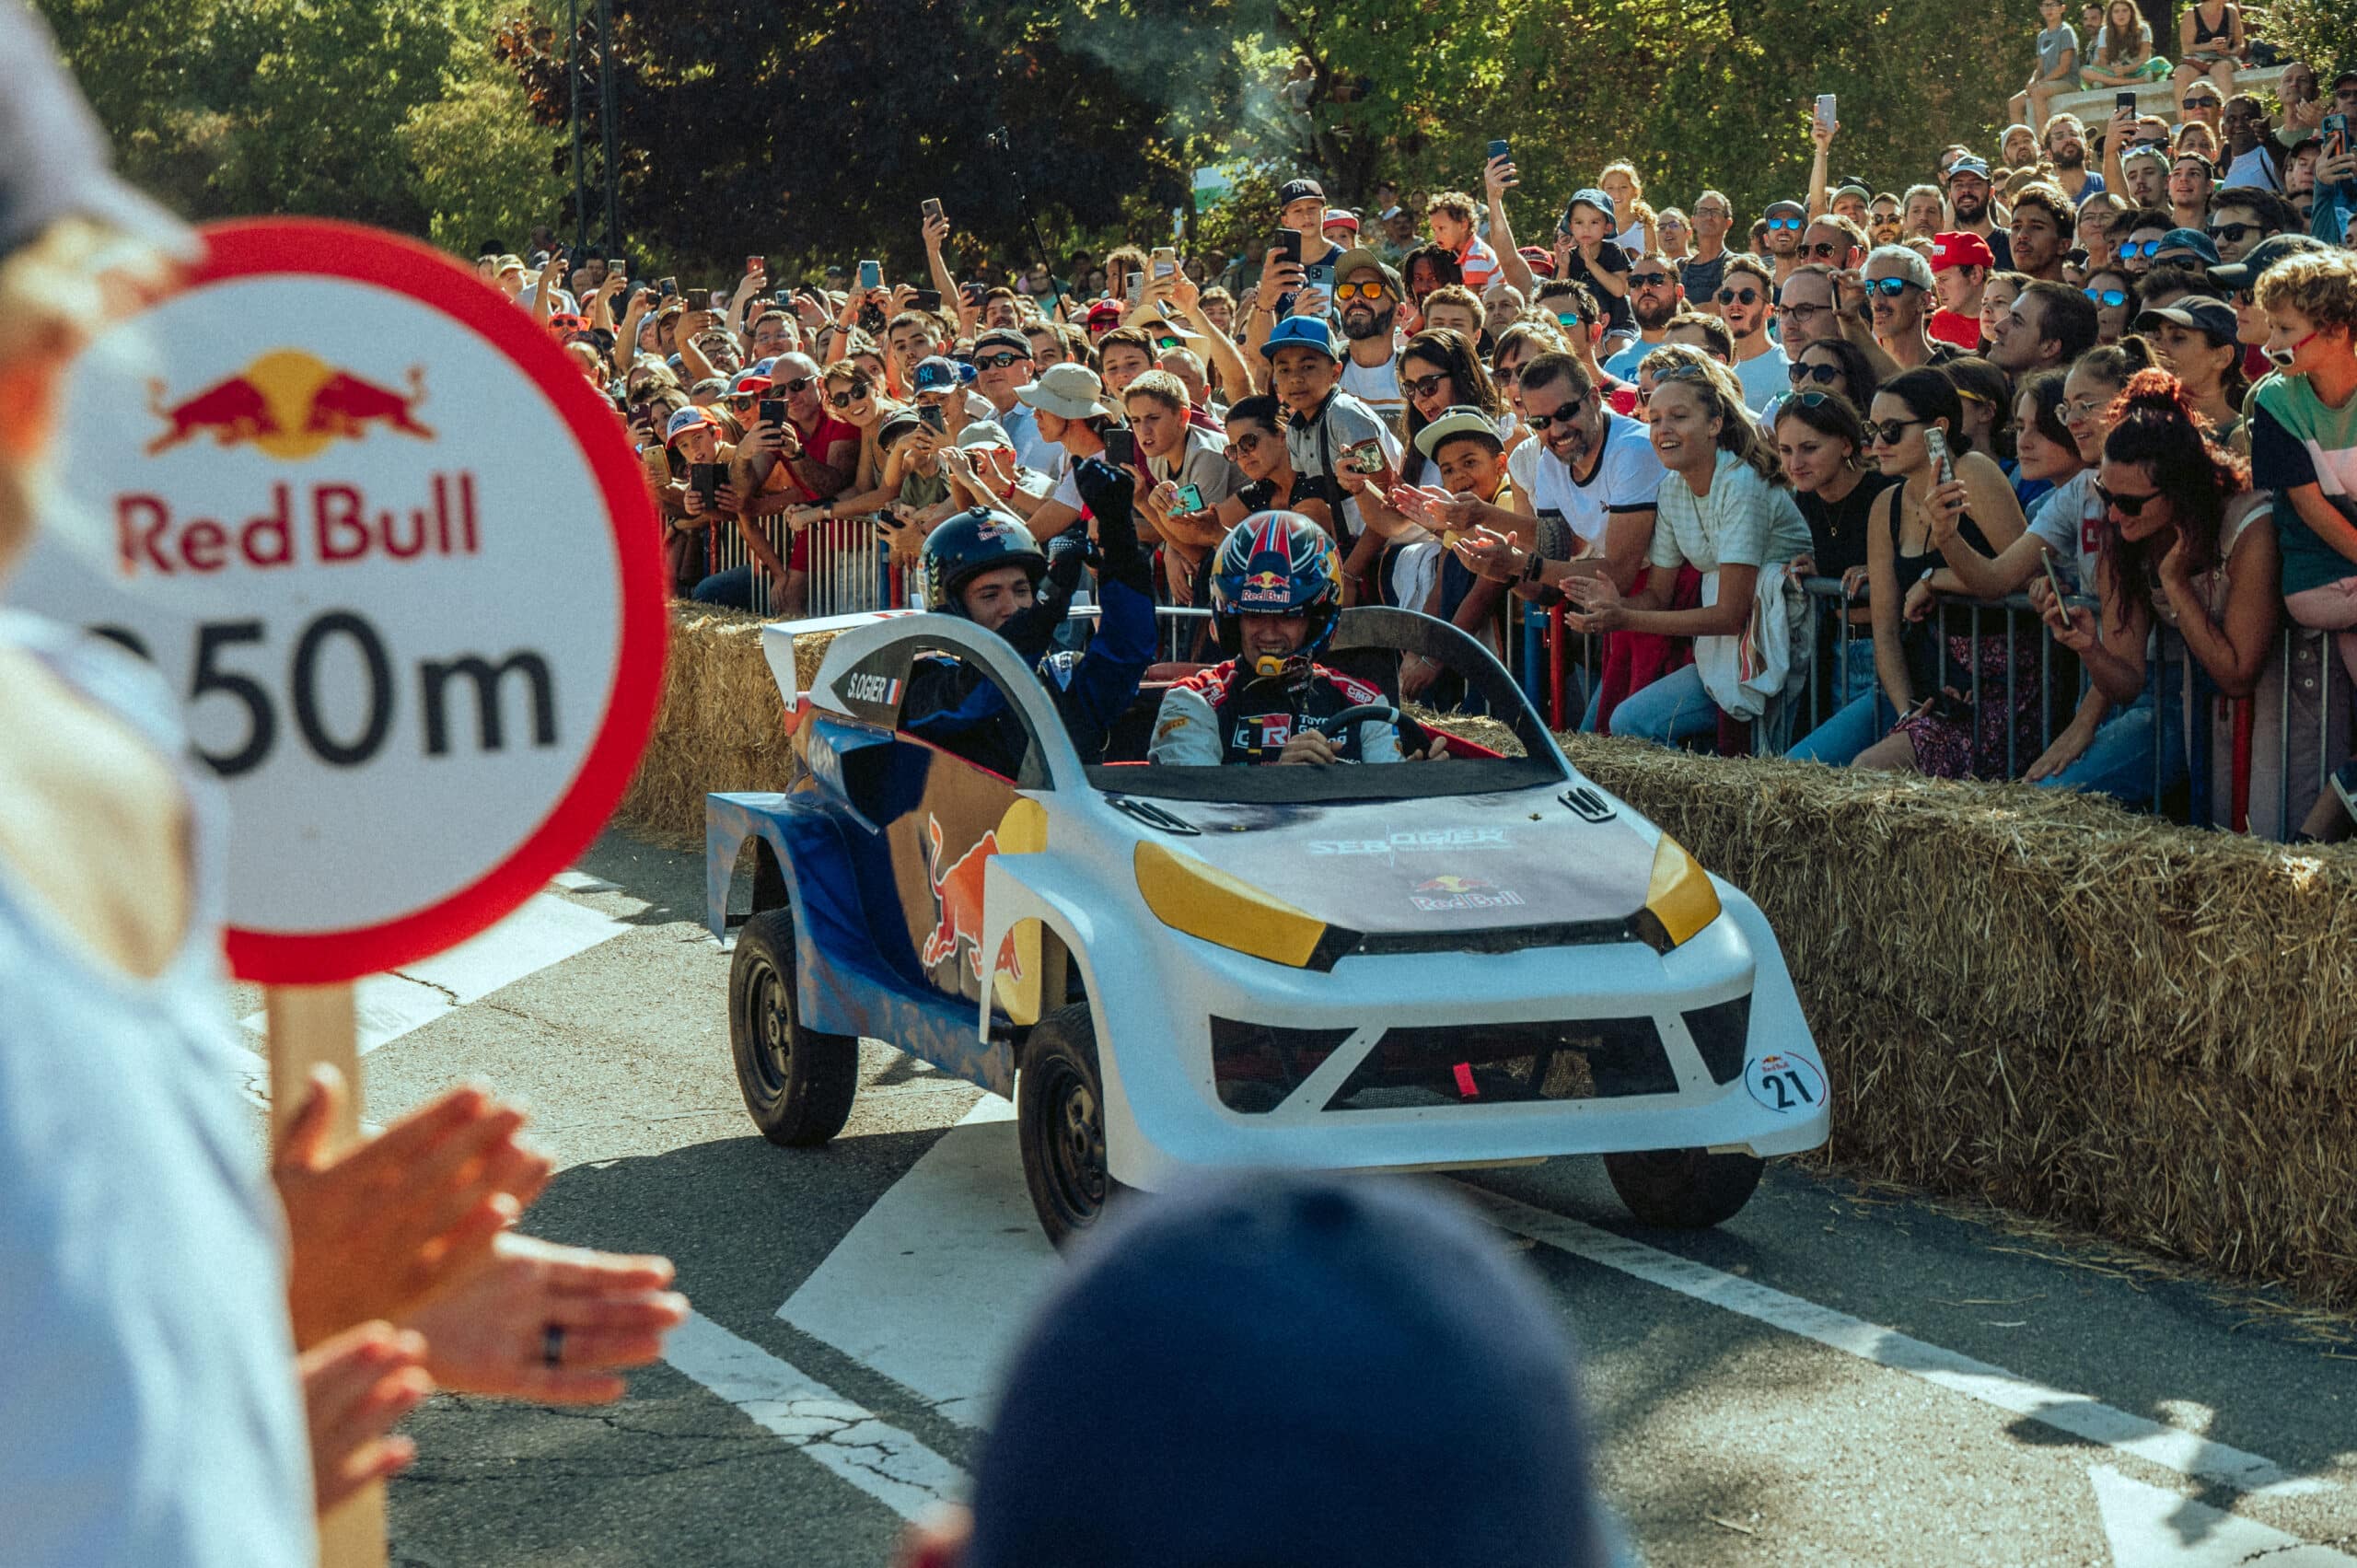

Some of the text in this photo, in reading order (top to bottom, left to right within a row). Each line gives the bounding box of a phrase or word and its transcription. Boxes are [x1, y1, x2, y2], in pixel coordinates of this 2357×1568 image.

[114, 470, 481, 575] Red Bull
[1241, 588, 1291, 603] Red Bull
[846, 671, 888, 703] S.OGIER
[1409, 890, 1527, 912] Red Bull
[1761, 1070, 1815, 1109] 21
